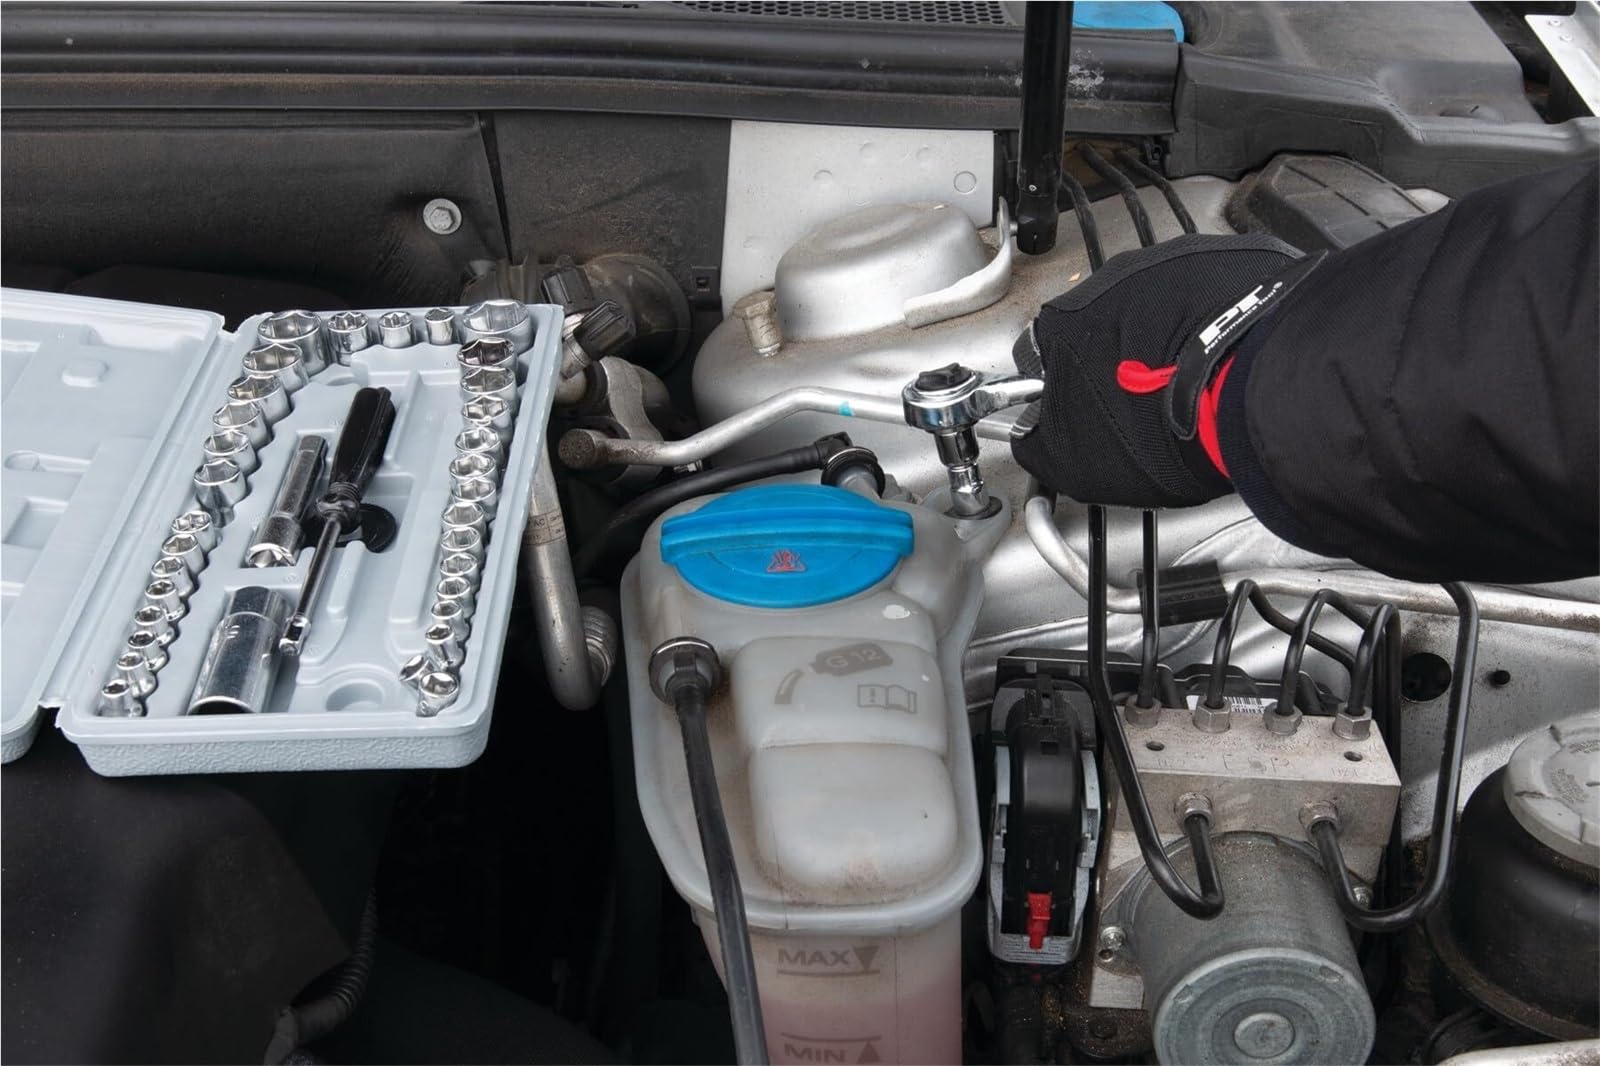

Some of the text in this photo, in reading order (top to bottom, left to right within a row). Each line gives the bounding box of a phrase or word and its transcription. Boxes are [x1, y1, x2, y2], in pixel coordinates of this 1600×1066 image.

[1199, 284, 1264, 346] PT
[777, 948, 850, 967] MAX
[784, 1042, 846, 1063] MIN
